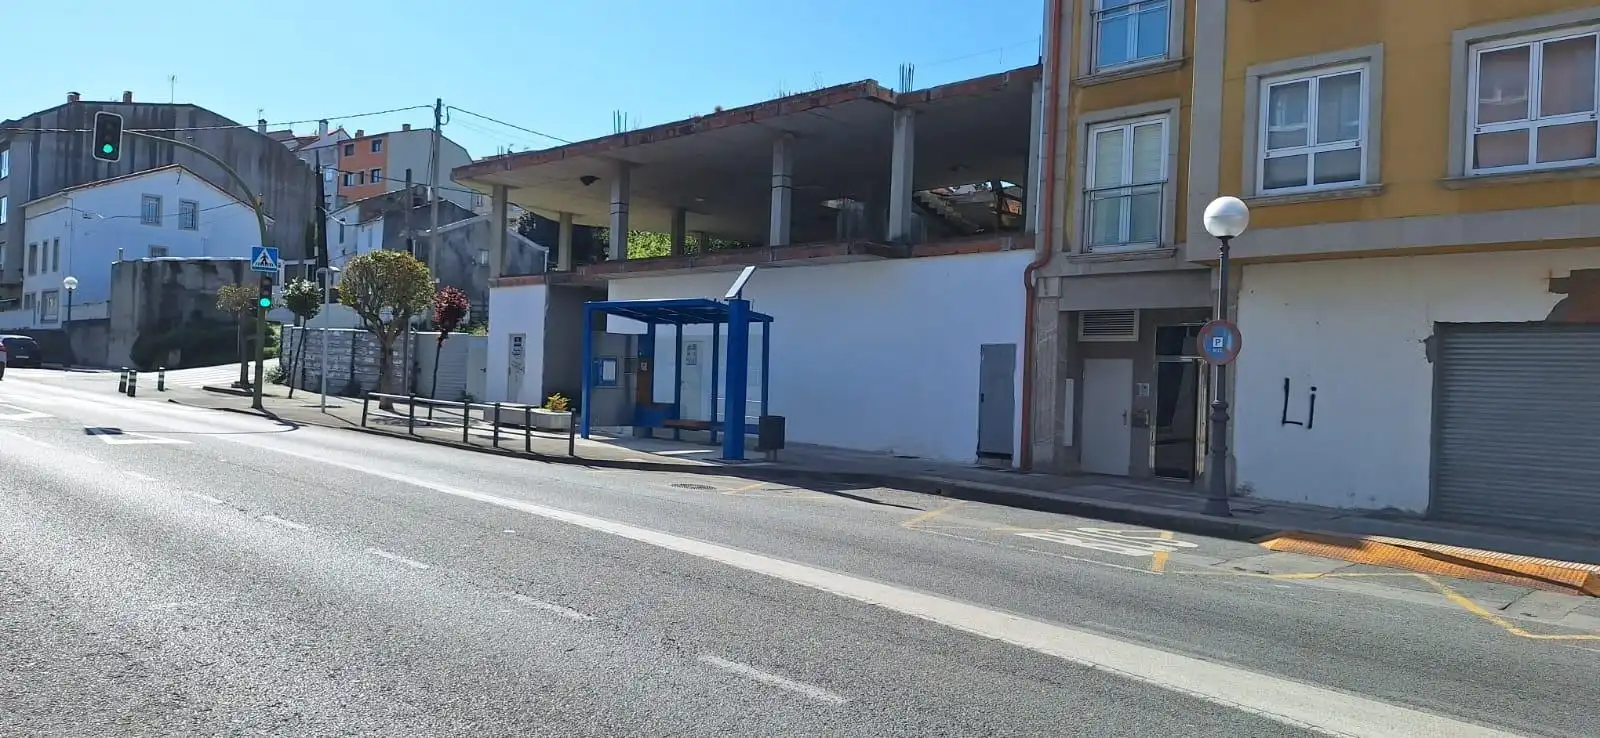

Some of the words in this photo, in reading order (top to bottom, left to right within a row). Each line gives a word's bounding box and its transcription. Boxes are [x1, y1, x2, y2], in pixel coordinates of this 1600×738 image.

[1214, 338, 1222, 346] P
[1281, 377, 1317, 429] Li
[1015, 527, 1199, 557] BUS
